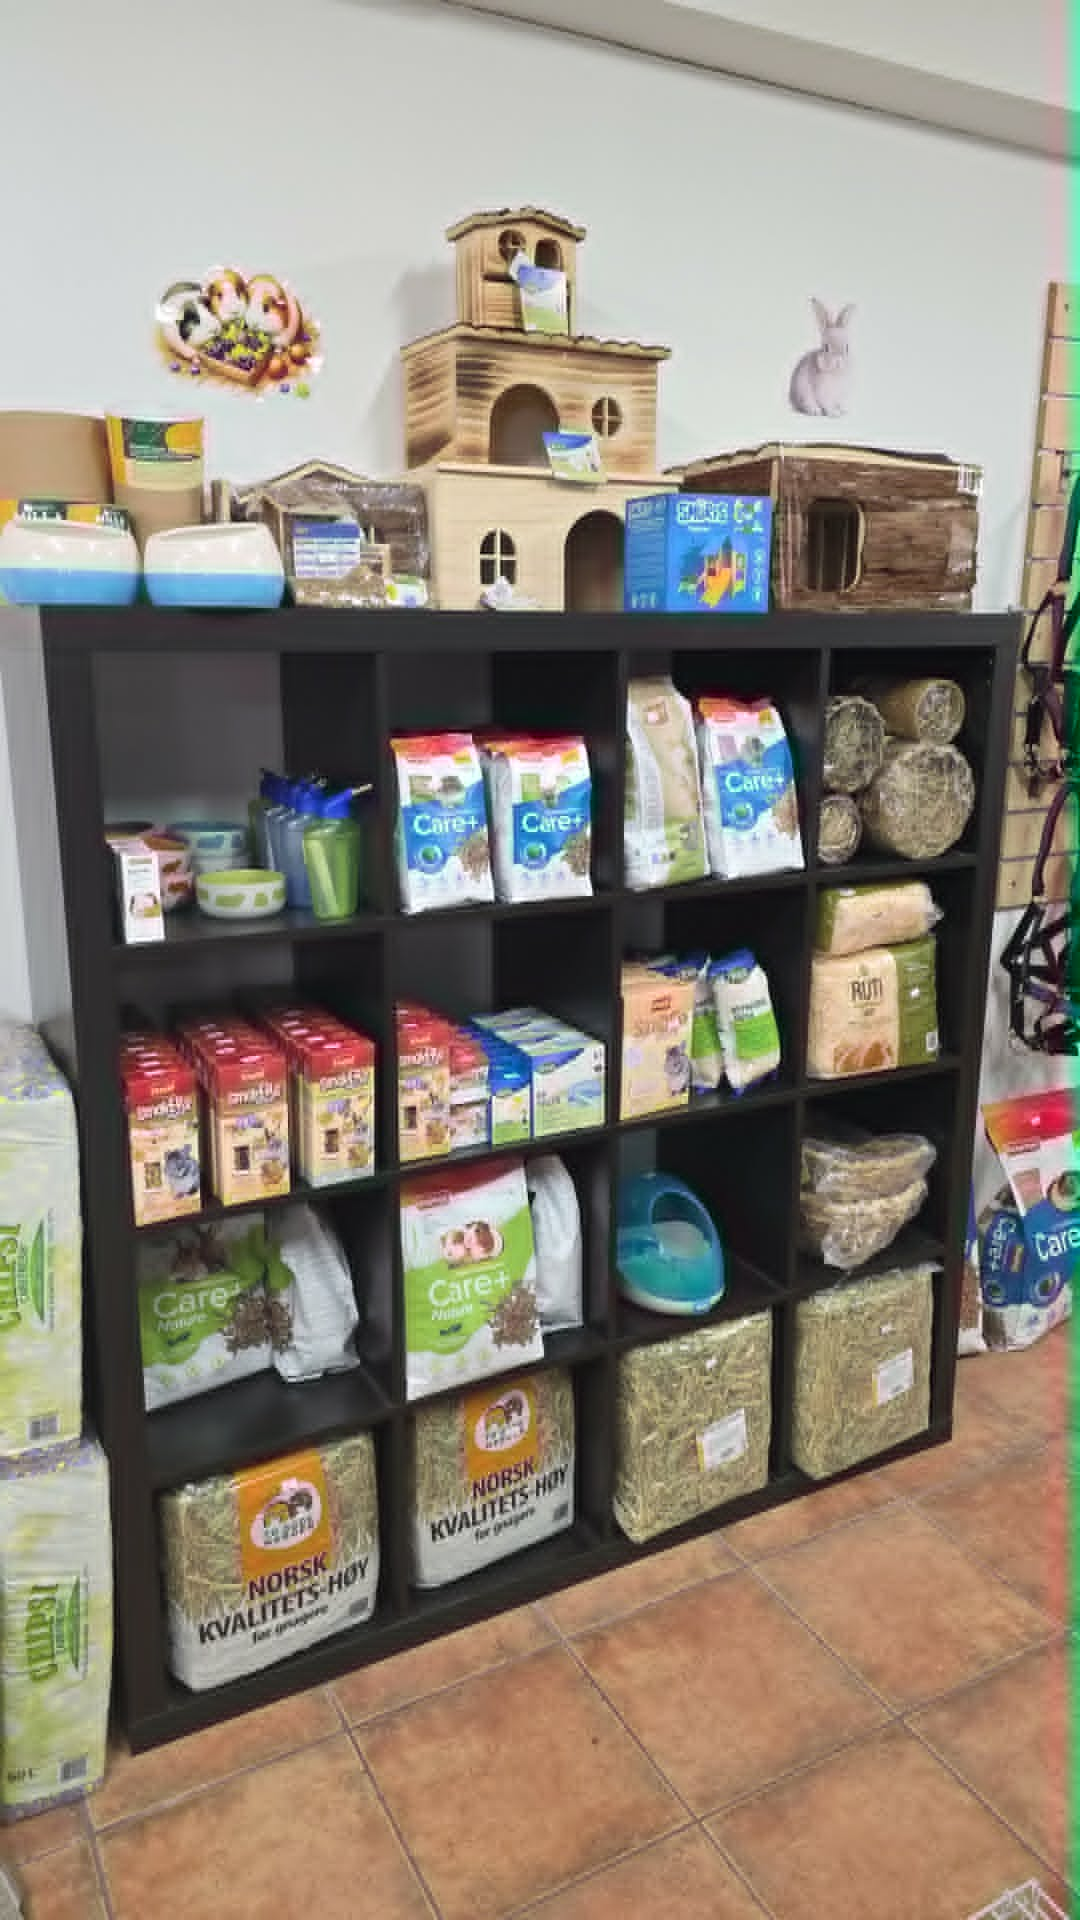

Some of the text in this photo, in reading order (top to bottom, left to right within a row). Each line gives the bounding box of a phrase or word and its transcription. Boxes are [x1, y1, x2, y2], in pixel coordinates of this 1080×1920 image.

[725, 768, 785, 793] Care+
[413, 812, 480, 835] Care+
[522, 811, 584, 833] Care+
[429, 1267, 510, 1307] Care+
[472, 1456, 535, 1501] NORSK
[431, 1463, 569, 1542] KVALITETS-HØY
[249, 1551, 328, 1600] NORSK
[199, 1556, 369, 1644] KVALITETS-HØY
